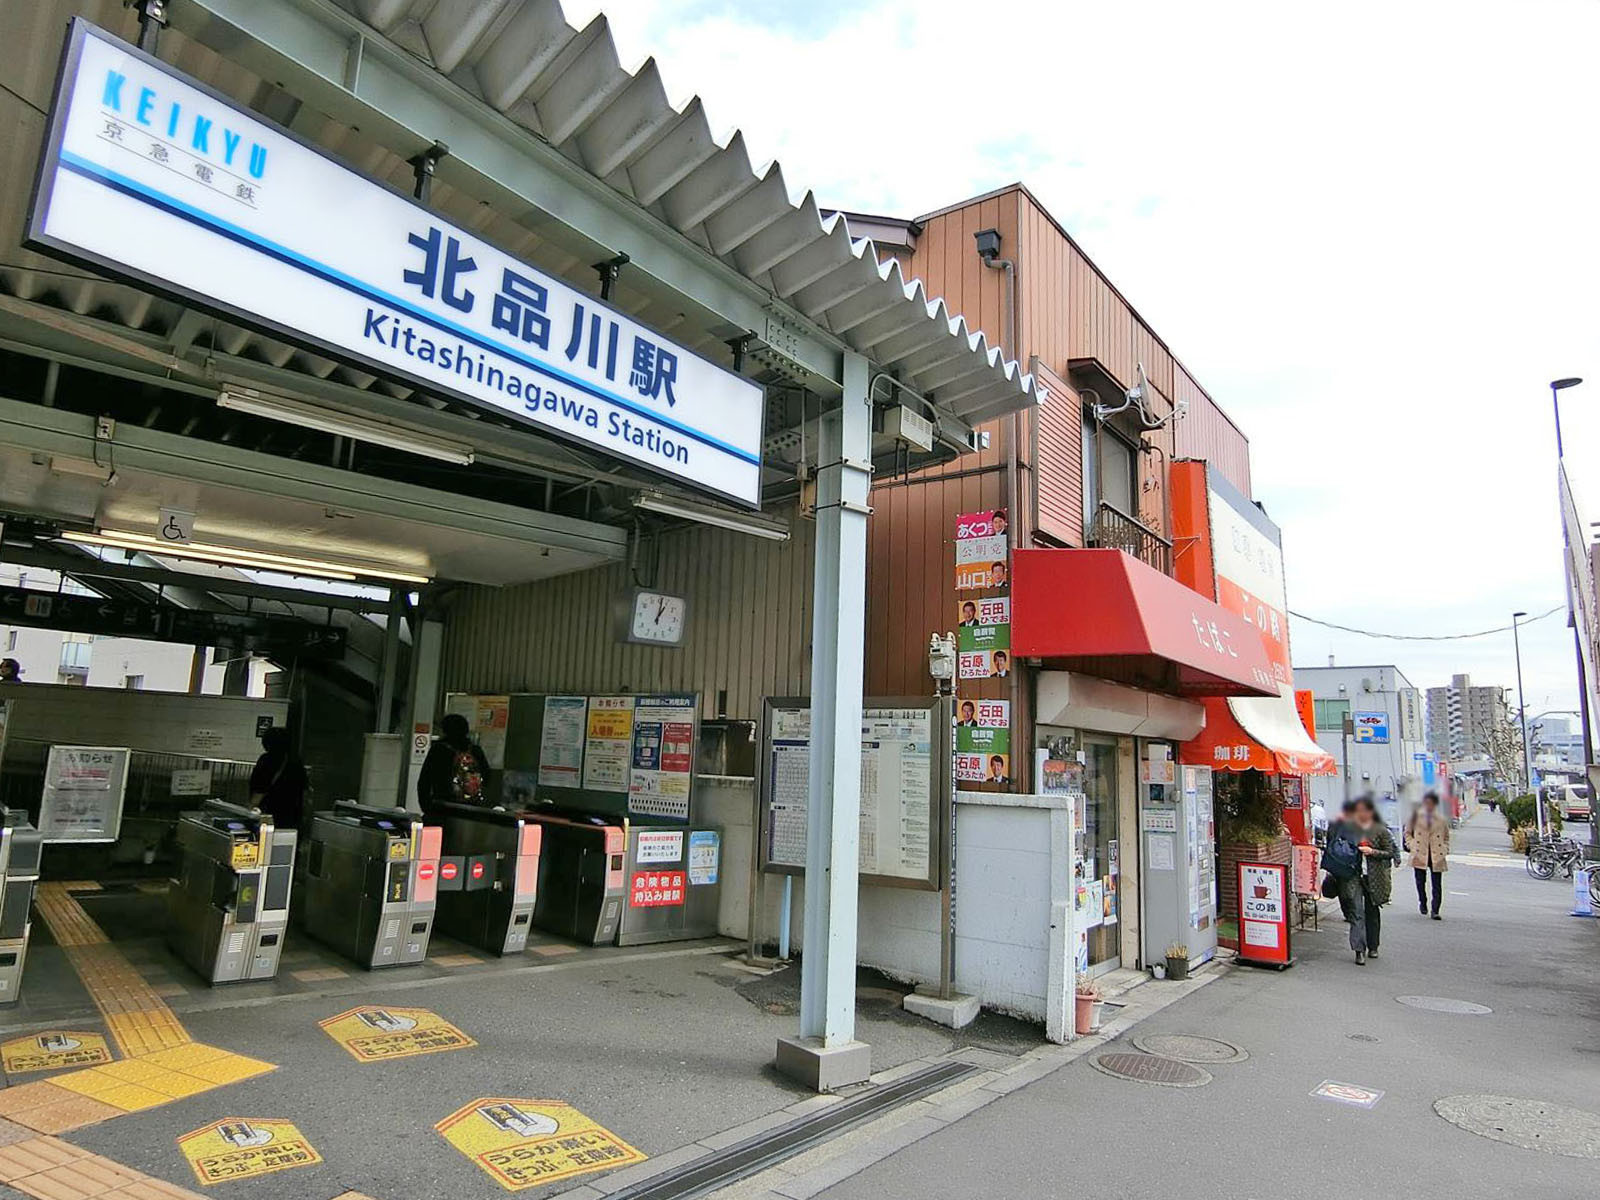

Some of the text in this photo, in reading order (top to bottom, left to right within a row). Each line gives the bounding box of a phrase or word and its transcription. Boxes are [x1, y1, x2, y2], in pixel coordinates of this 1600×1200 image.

[102, 70, 268, 180] KEIKYU
[103, 119, 255, 204] 京急電鉄
[403, 226, 679, 408] 北品川駅
[363, 308, 690, 465] Kitashinagawa Station
[958, 522, 988, 539] あくつ
[962, 543, 1002, 558] 公明党
[957, 571, 985, 588] 山口
[980, 602, 1004, 616] 石田
[980, 615, 1009, 625] ひでお
[1191, 610, 1239, 658] たばこ
[960, 654, 984, 668] 石原
[960, 668, 990, 677] ひろたか
[979, 704, 1004, 718] 石田
[979, 717, 1009, 727] ひでお
[64, 753, 113, 764] お知らせ
[1213, 745, 1250, 761] 珈琲
[957, 756, 981, 770] 石原
[957, 770, 986, 780] ひろたか
[1246, 901, 1277, 913] この路
